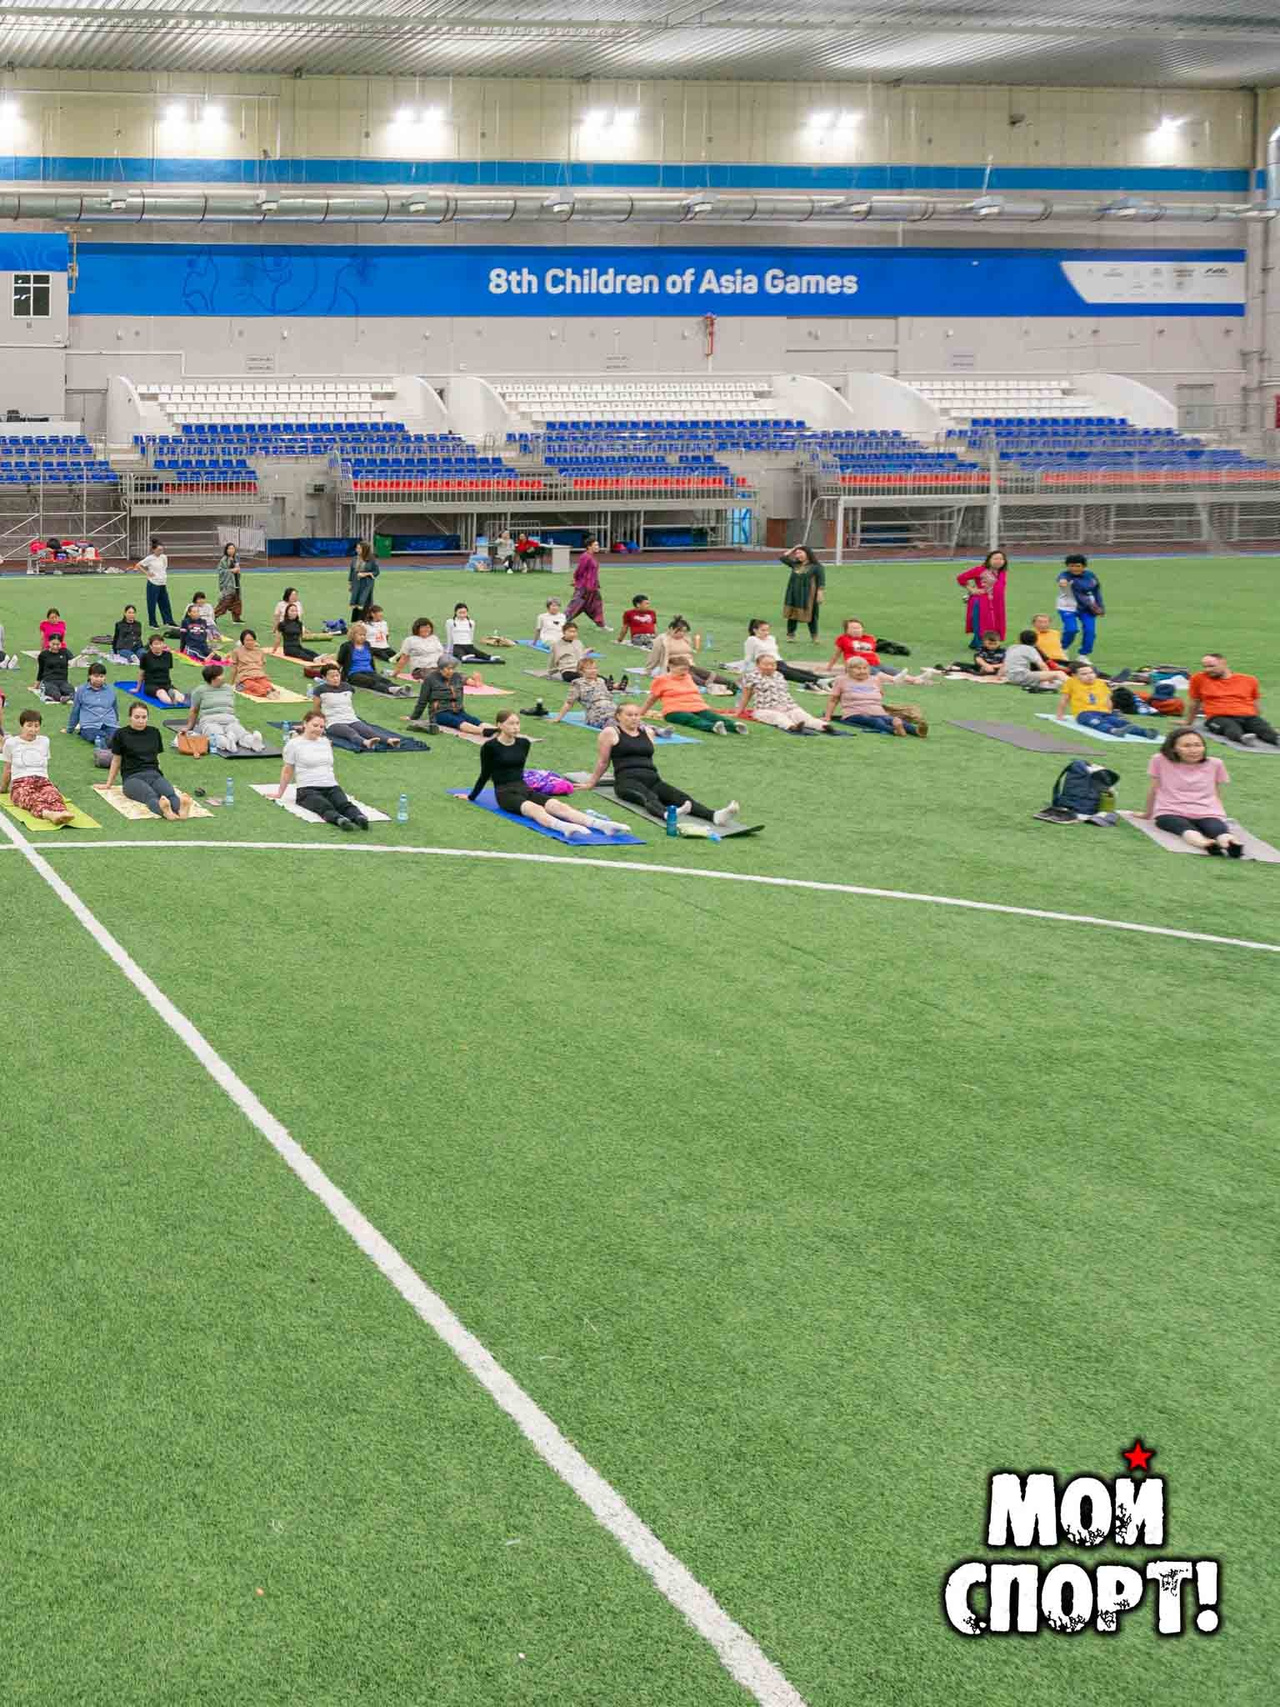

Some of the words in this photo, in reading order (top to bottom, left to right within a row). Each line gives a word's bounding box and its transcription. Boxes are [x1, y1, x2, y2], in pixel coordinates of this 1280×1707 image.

[488, 268, 538, 295] 8th
[545, 268, 659, 295] Children
[665, 268, 695, 295] of
[699, 268, 758, 295] Asia
[764, 269, 859, 295] Games
